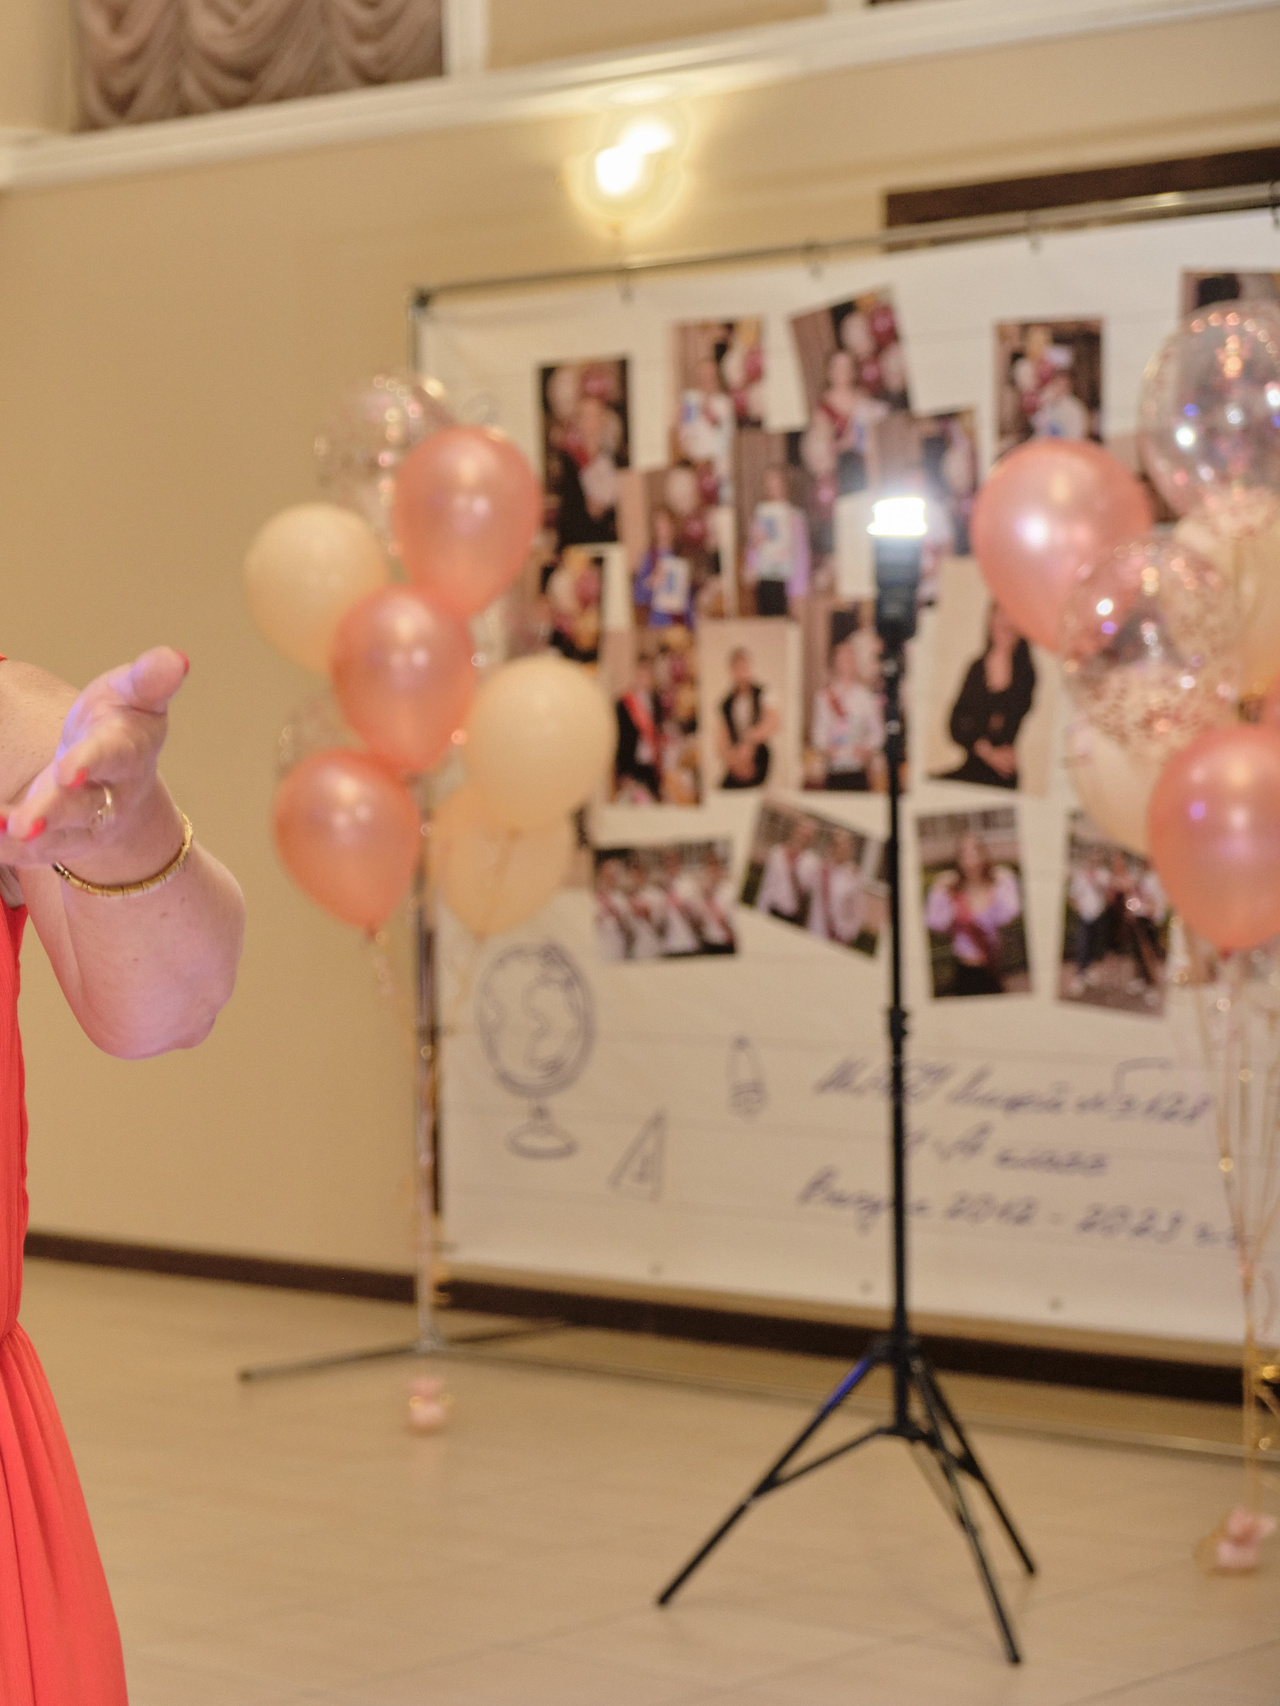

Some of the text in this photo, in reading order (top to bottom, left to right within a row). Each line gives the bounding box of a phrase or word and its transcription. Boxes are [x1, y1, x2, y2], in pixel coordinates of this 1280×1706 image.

[798, 1164, 930, 1237] Выпук
[945, 1190, 1040, 1227] 2012
[1076, 1202, 1186, 1245] 2023
